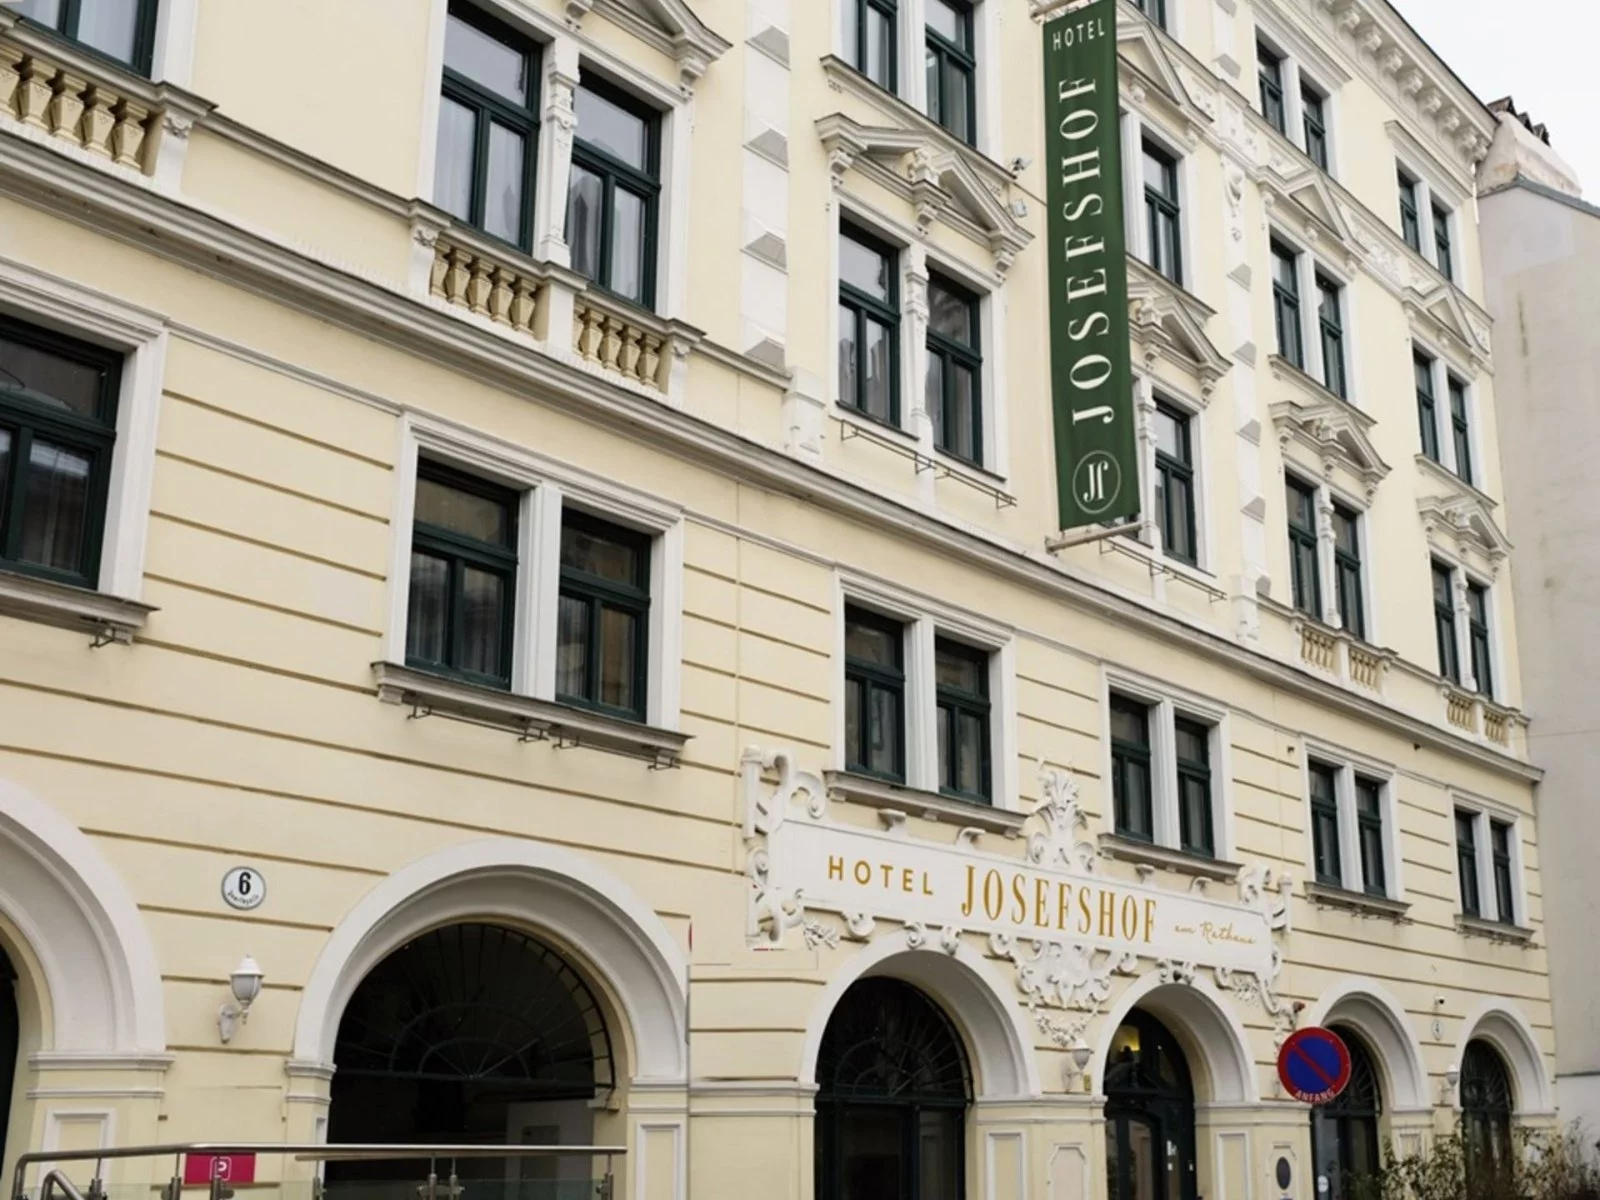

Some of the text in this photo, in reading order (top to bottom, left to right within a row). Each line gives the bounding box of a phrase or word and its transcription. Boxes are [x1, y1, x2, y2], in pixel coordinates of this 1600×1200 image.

[1053, 17, 1106, 51] HOTEL
[1059, 75, 1114, 426] JOSEFSHOF
[239, 871, 251, 895] 6
[828, 856, 933, 896] HOTEL
[961, 865, 1157, 943] JOSEFSHOF
